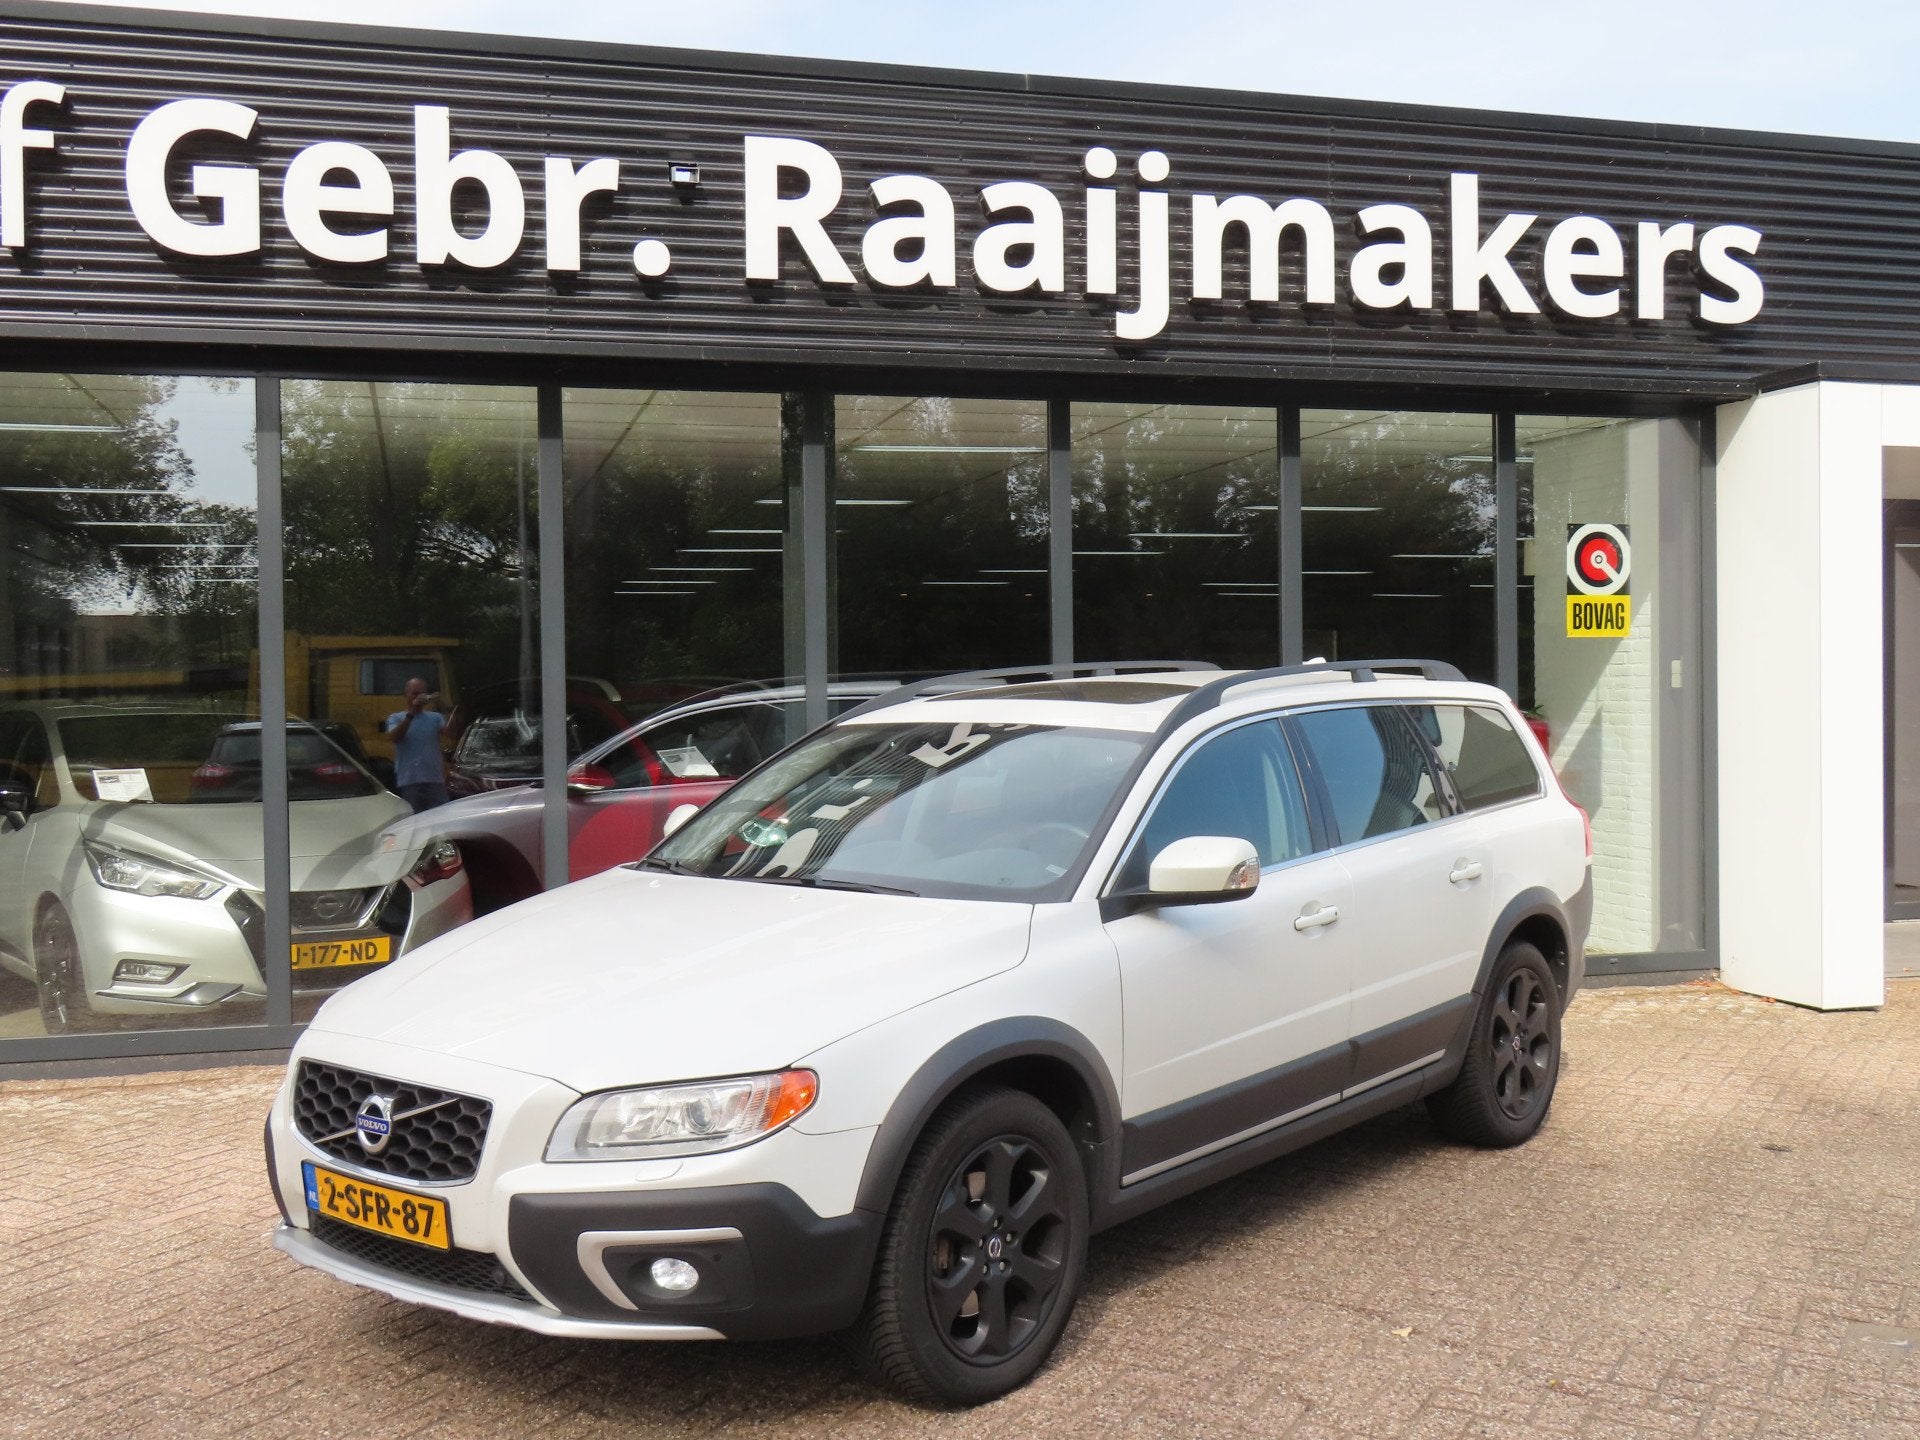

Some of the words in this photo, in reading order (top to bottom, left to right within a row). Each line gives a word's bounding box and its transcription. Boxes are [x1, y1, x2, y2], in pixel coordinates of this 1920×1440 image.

[126, 99, 671, 278] Gebr.
[744, 135, 1764, 340] Raaijmakers
[1572, 602, 1625, 630] BOVAG
[292, 942, 378, 966] J-177-ND
[357, 1117, 388, 1132] VOLVO
[308, 1190, 319, 1203] NL
[324, 1177, 435, 1238] 2-SFR-87
